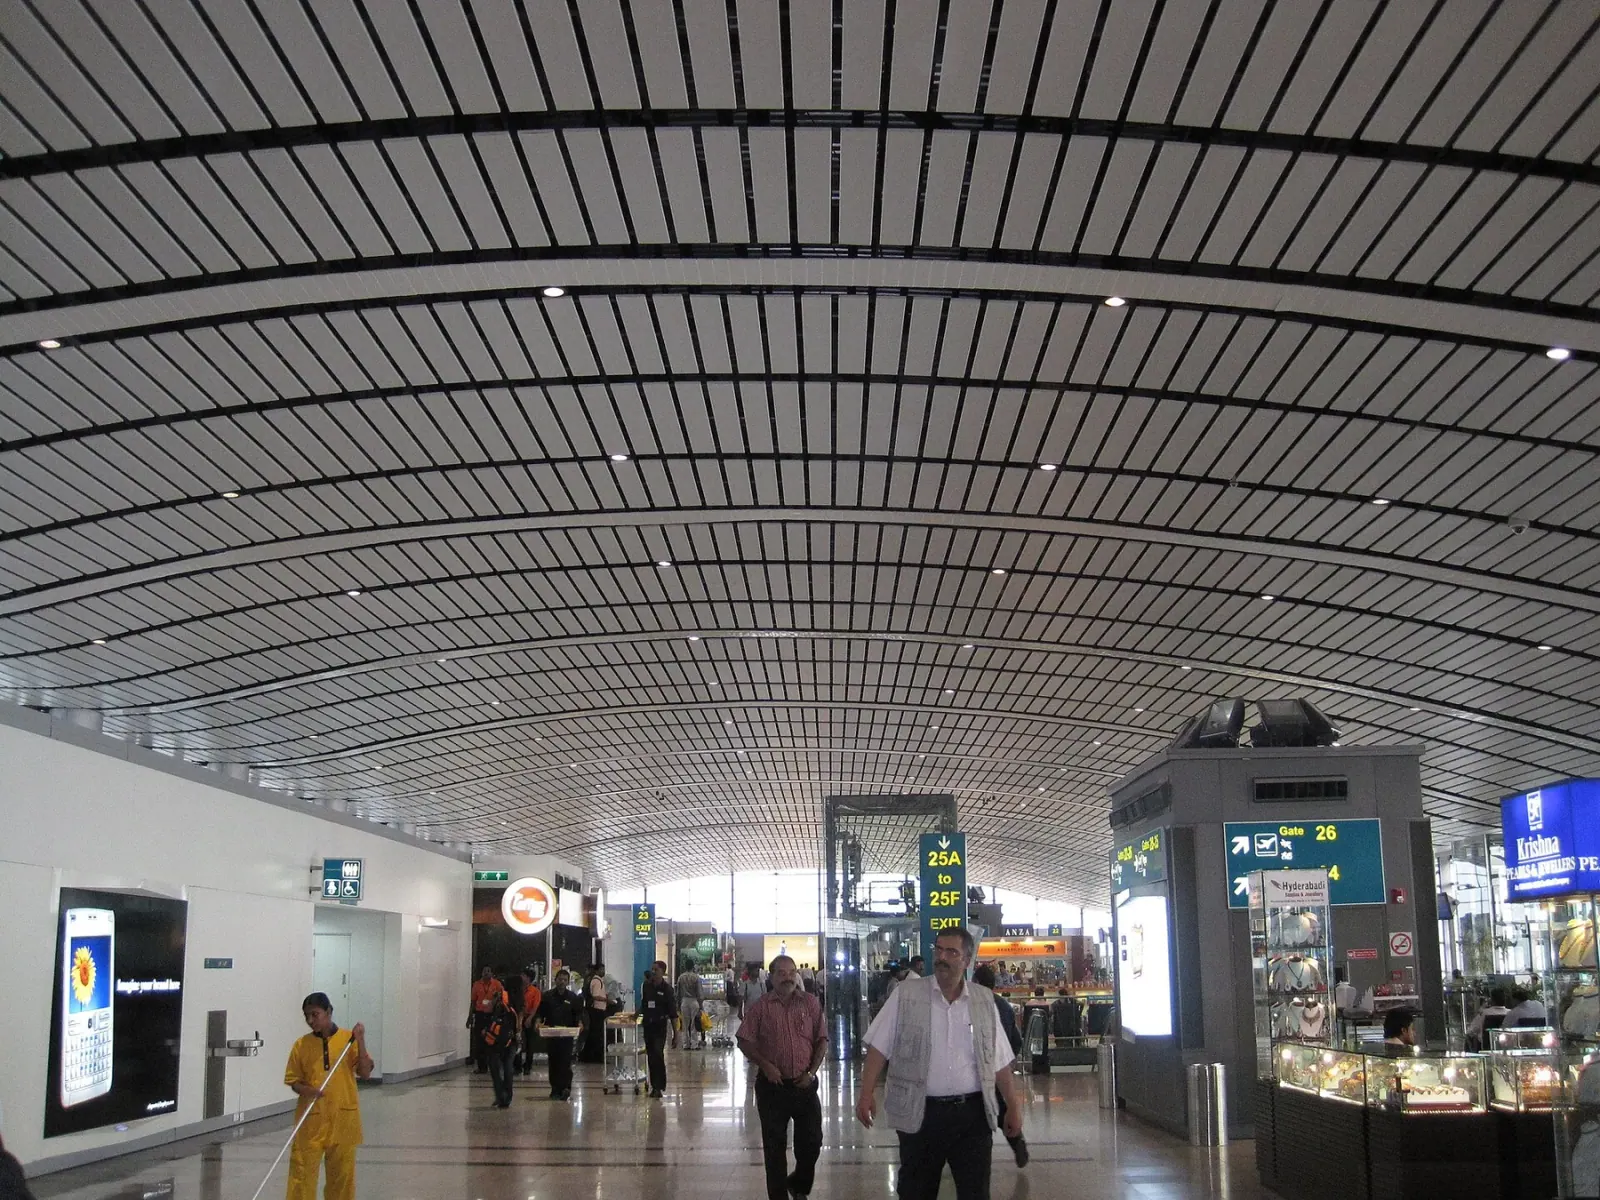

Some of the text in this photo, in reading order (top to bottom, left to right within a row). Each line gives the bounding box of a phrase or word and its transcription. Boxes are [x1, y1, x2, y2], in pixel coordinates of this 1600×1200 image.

[1279, 825, 1337, 840] Gate 26
[1516, 834, 1560, 860] Krishna
[928, 851, 961, 866] 25A
[1537, 856, 1576, 878] JEWELLERS
[938, 873, 952, 884] to
[1282, 881, 1326, 892] Hyderabadi
[929, 891, 960, 906] 25F
[638, 911, 649, 919] 23
[930, 918, 961, 930] EXIT
[698, 937, 715, 947] idli
